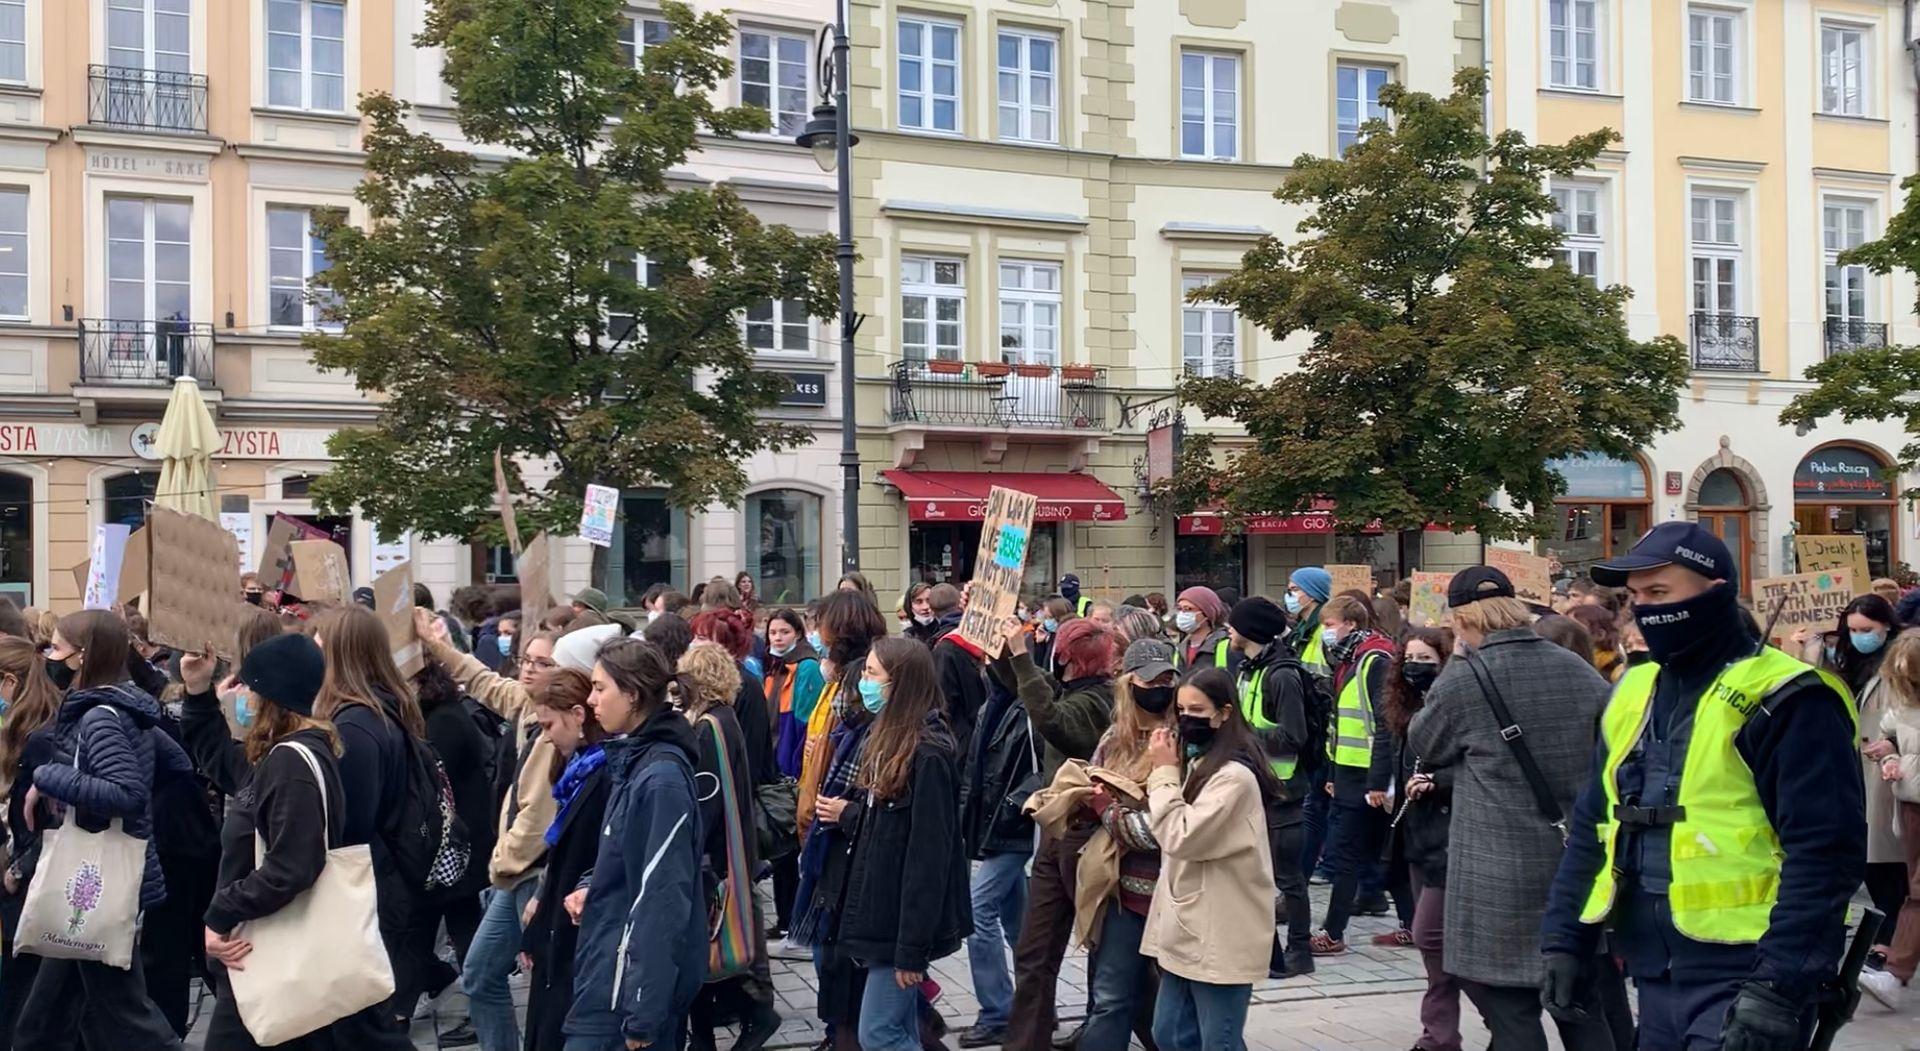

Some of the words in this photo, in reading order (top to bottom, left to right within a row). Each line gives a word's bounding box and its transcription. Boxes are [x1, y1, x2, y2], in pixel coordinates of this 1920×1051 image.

[165, 160, 205, 176] SAXE
[216, 431, 280, 455] ZYSTA
[1035, 506, 1072, 518] UBINO
[1674, 545, 1715, 569] POLICJA
[41, 931, 106, 951] Montenegro
